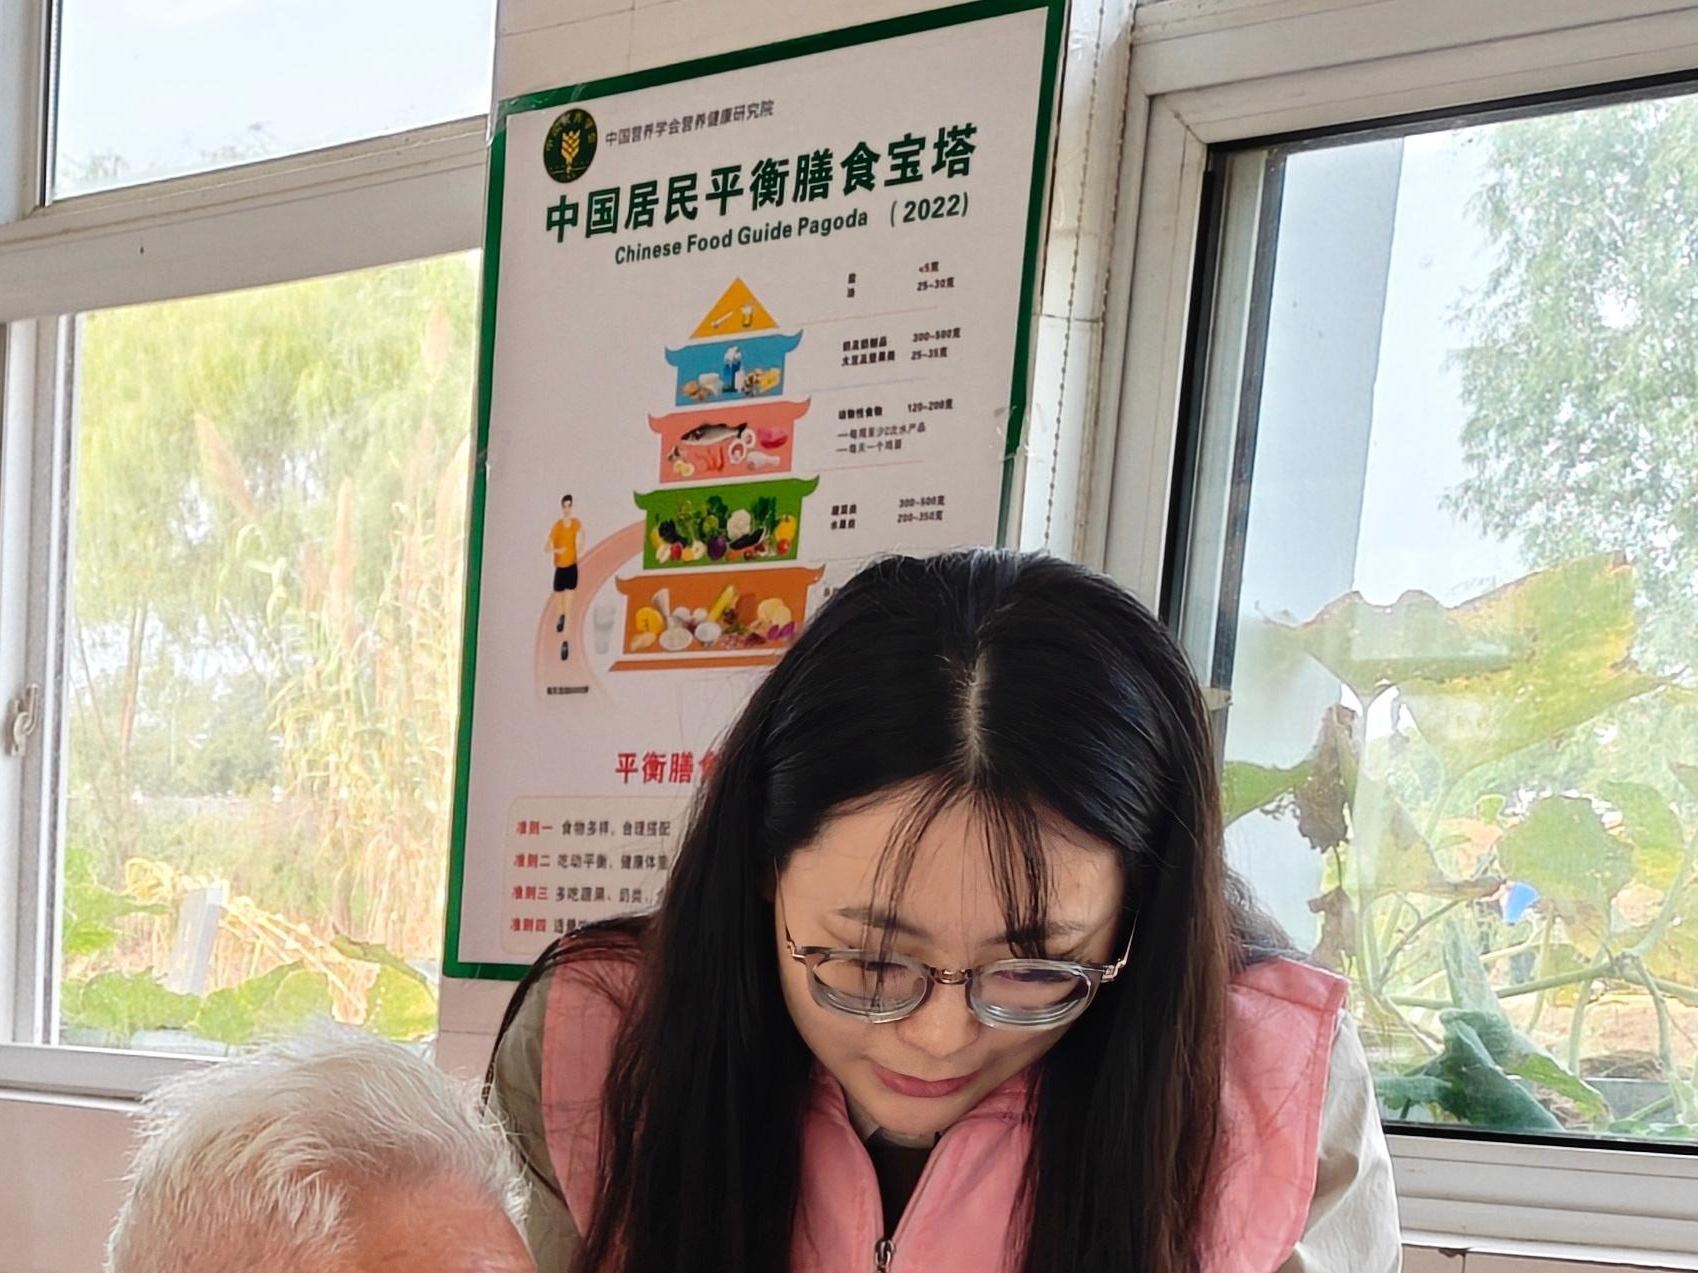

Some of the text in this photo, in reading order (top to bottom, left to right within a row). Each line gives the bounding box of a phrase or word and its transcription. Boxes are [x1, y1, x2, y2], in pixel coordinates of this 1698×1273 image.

[605, 100, 774, 147] 中国营养学会营养健康研究院
[546, 122, 977, 243] 中国居民平衡膳食宝塔
[615, 241, 682, 265] Chinese
[687, 228, 733, 253] Food
[738, 220, 792, 245] Guide
[797, 208, 868, 237] Pagoda
[516, 821, 553, 836] 准则一
[514, 854, 550, 868] 准则二
[512, 886, 548, 901] 准则三
[510, 918, 546, 933] 准则四
